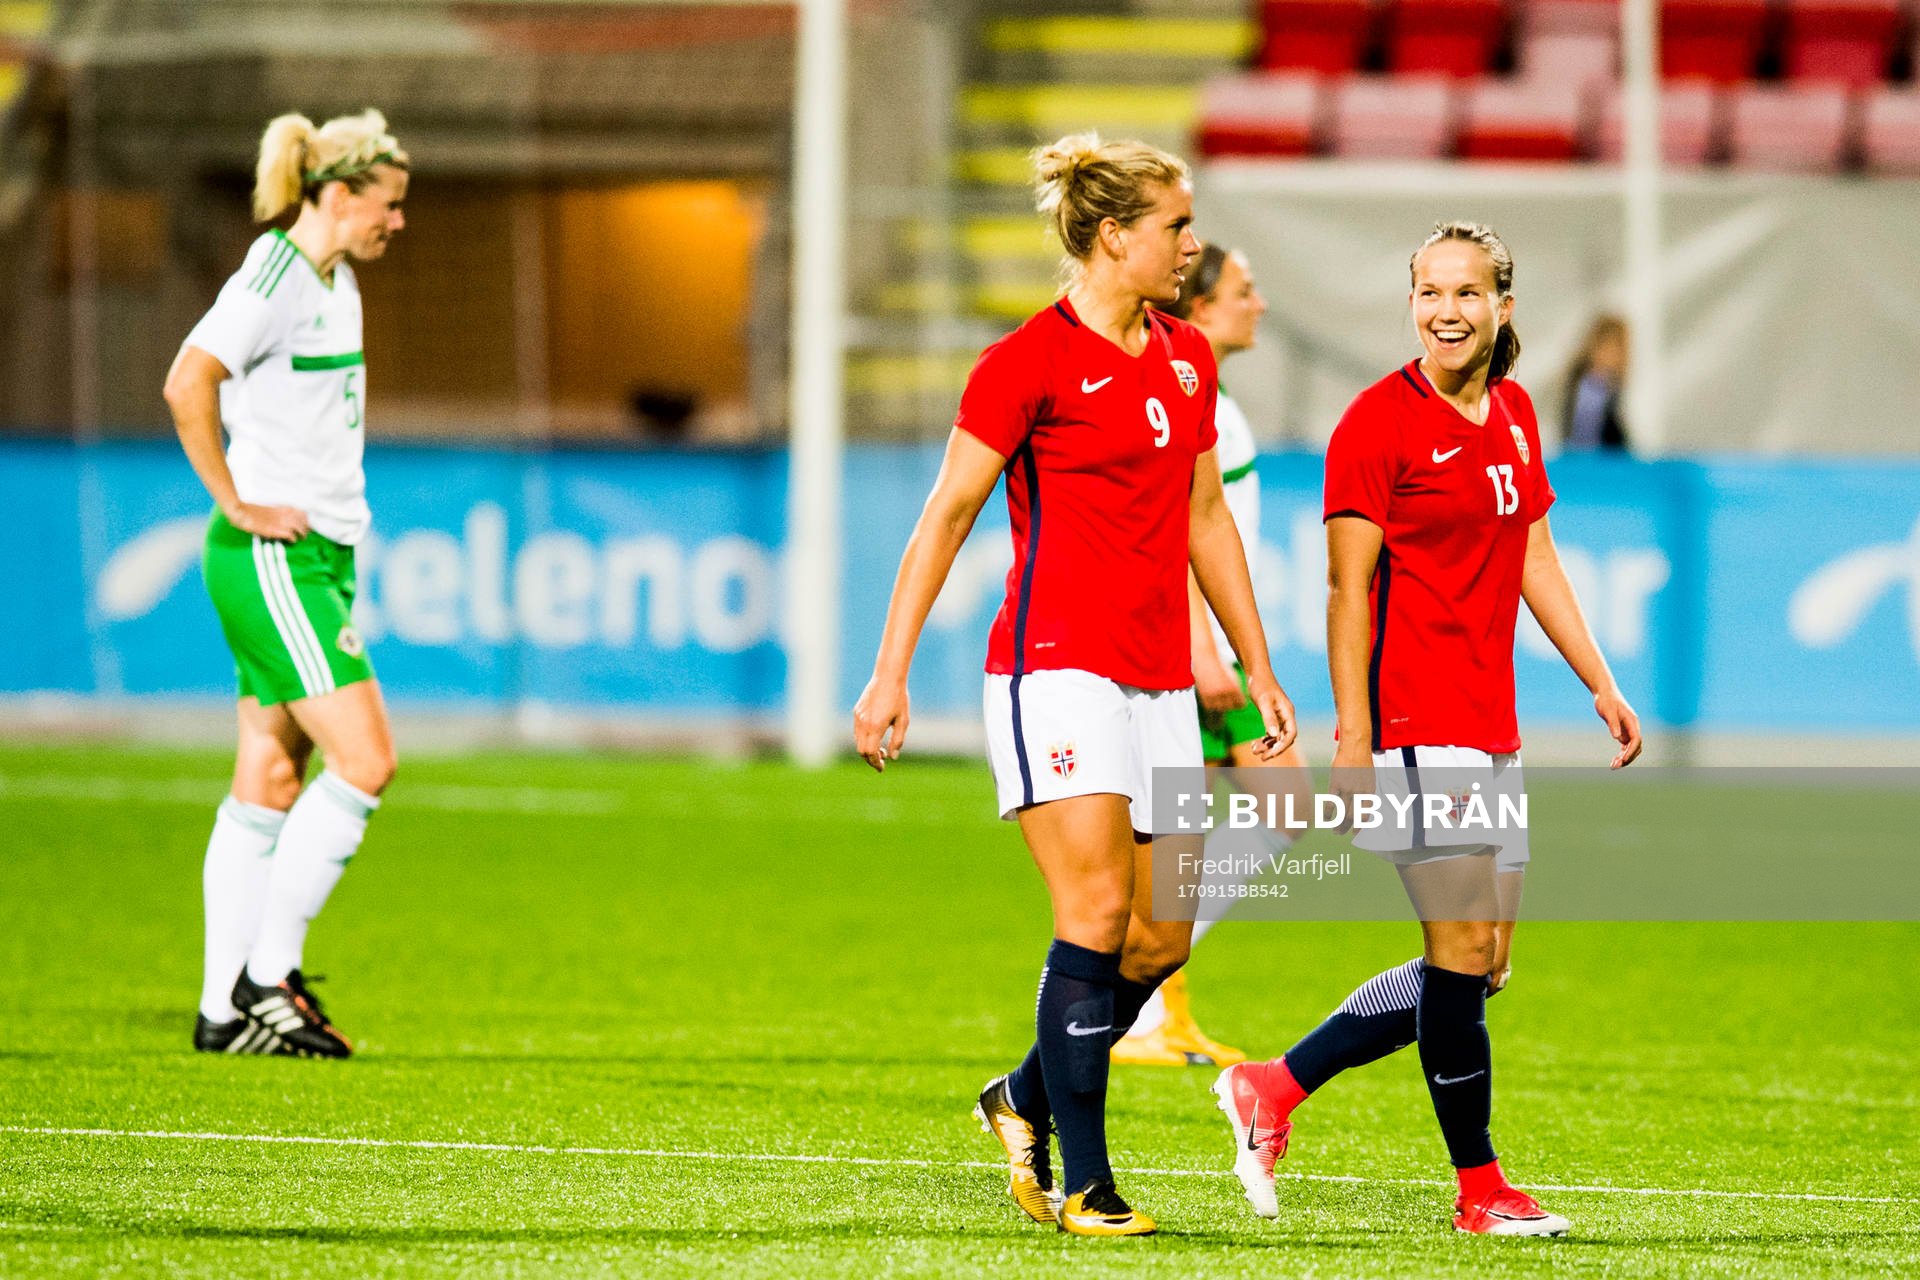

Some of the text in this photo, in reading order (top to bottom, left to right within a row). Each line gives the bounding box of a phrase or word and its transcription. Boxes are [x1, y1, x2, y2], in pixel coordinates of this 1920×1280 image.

[344, 371, 360, 429] 5
[1145, 396, 1171, 448] 9
[1485, 464, 1519, 516] 13
[354, 502, 794, 652] eleno
